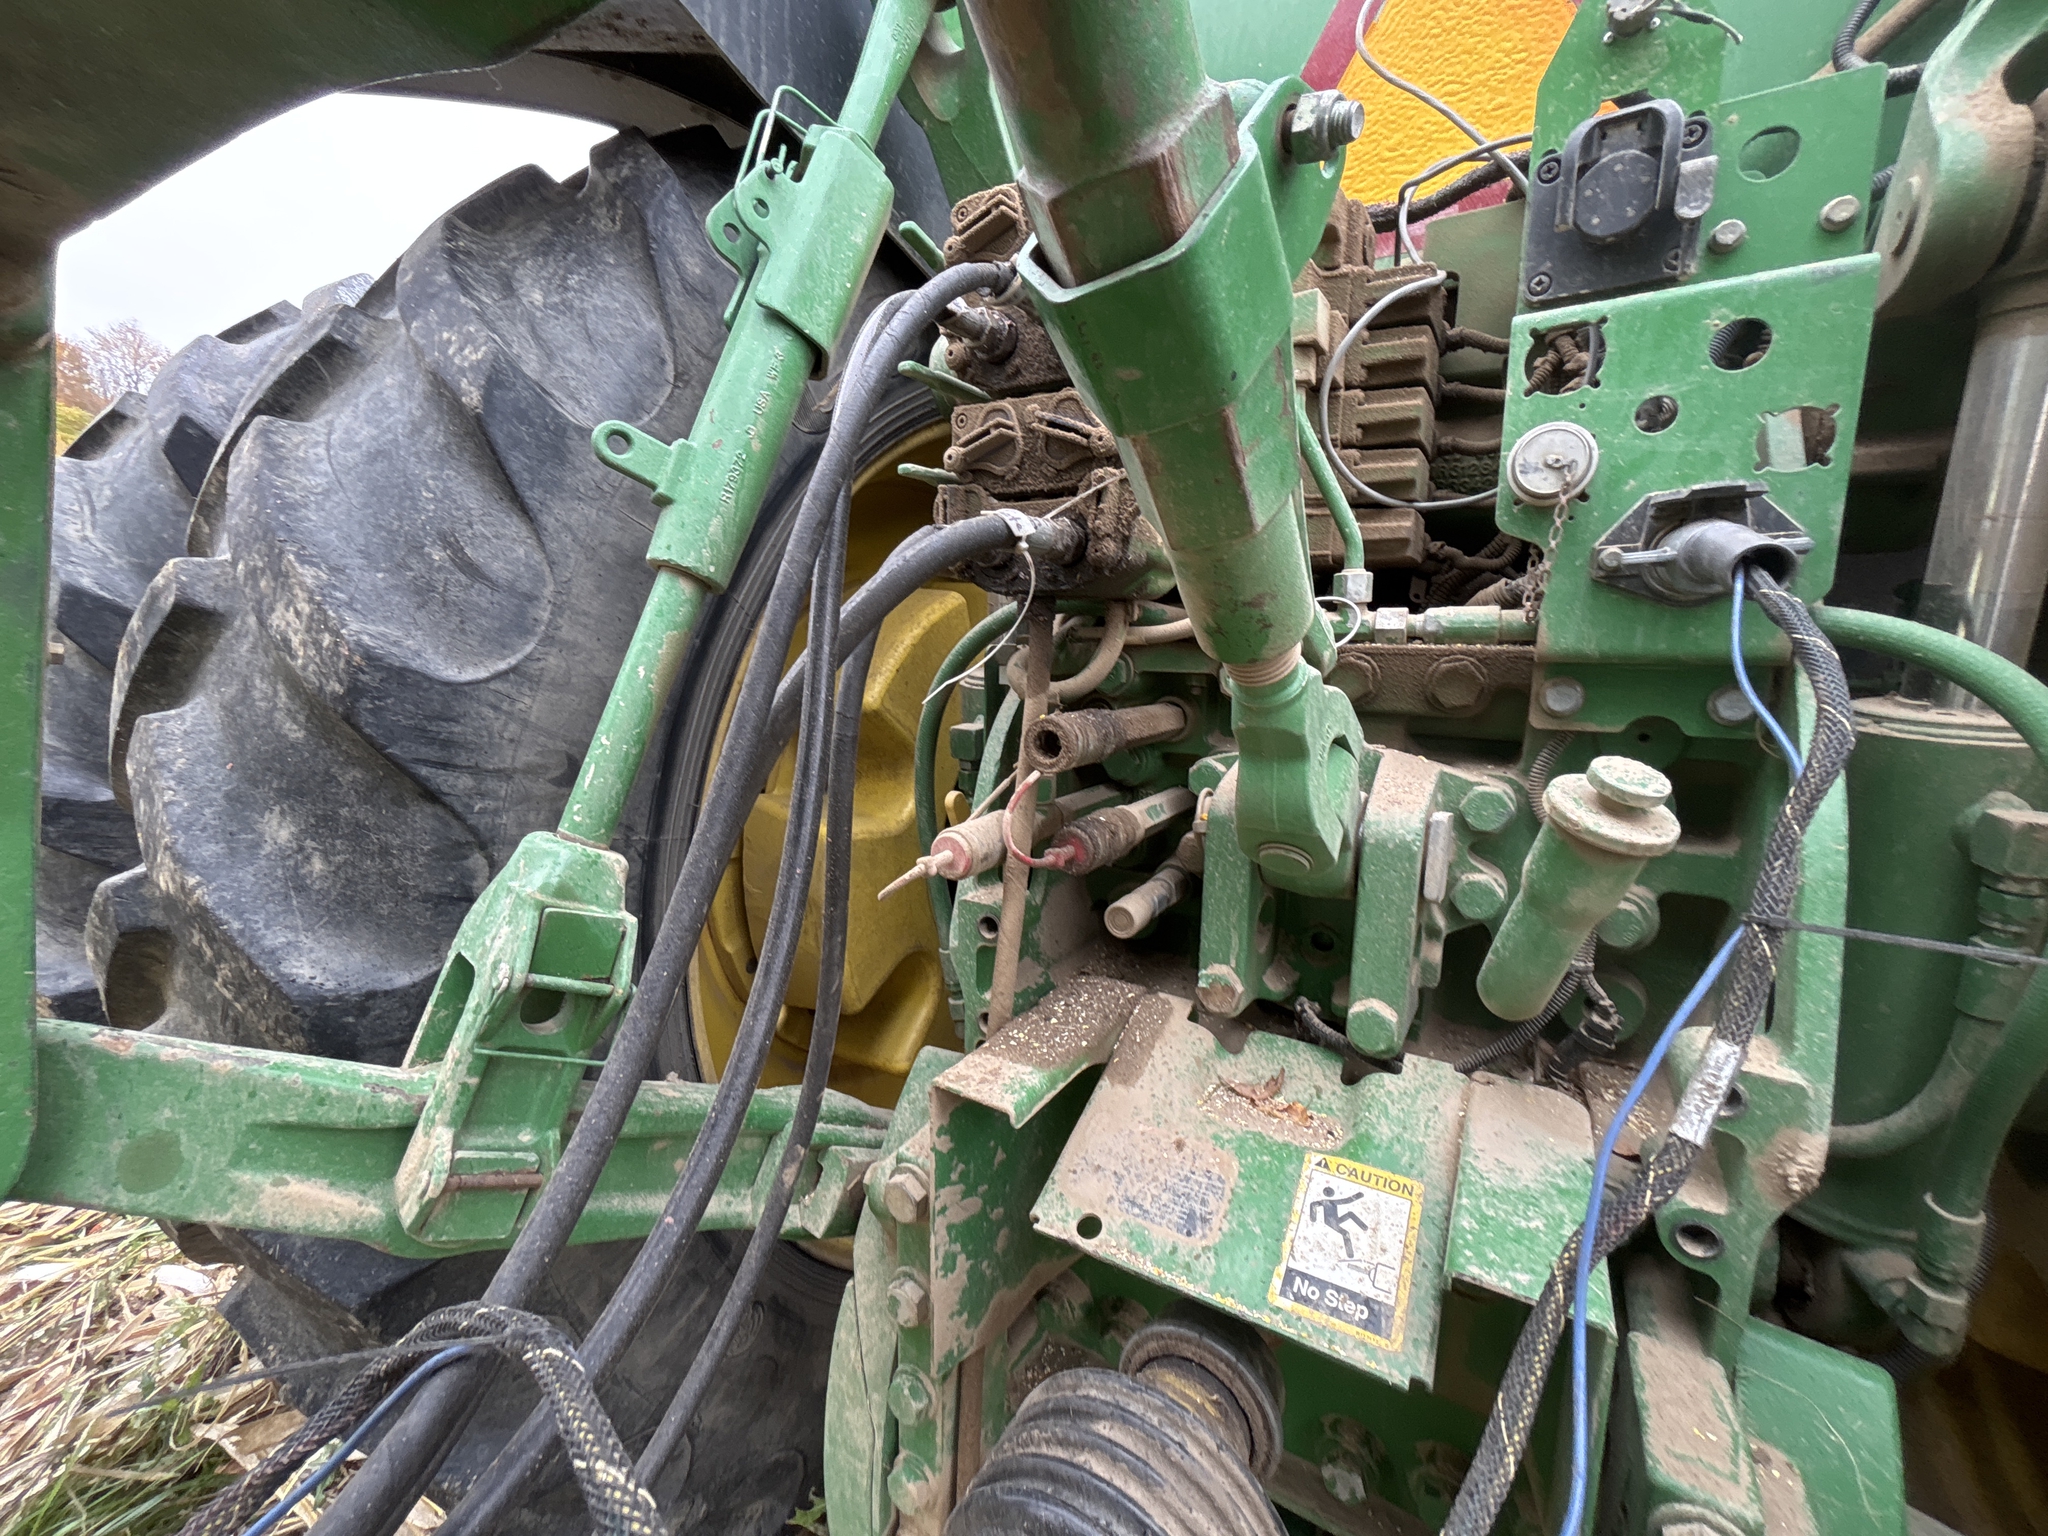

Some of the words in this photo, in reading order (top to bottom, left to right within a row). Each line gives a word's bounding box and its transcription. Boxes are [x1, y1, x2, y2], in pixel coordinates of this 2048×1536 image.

[753, 391, 771, 416] USA
[1336, 1163, 1414, 1197] CAUTION
[1293, 1276, 1319, 1301] No
[1324, 1291, 1369, 1321] Step
